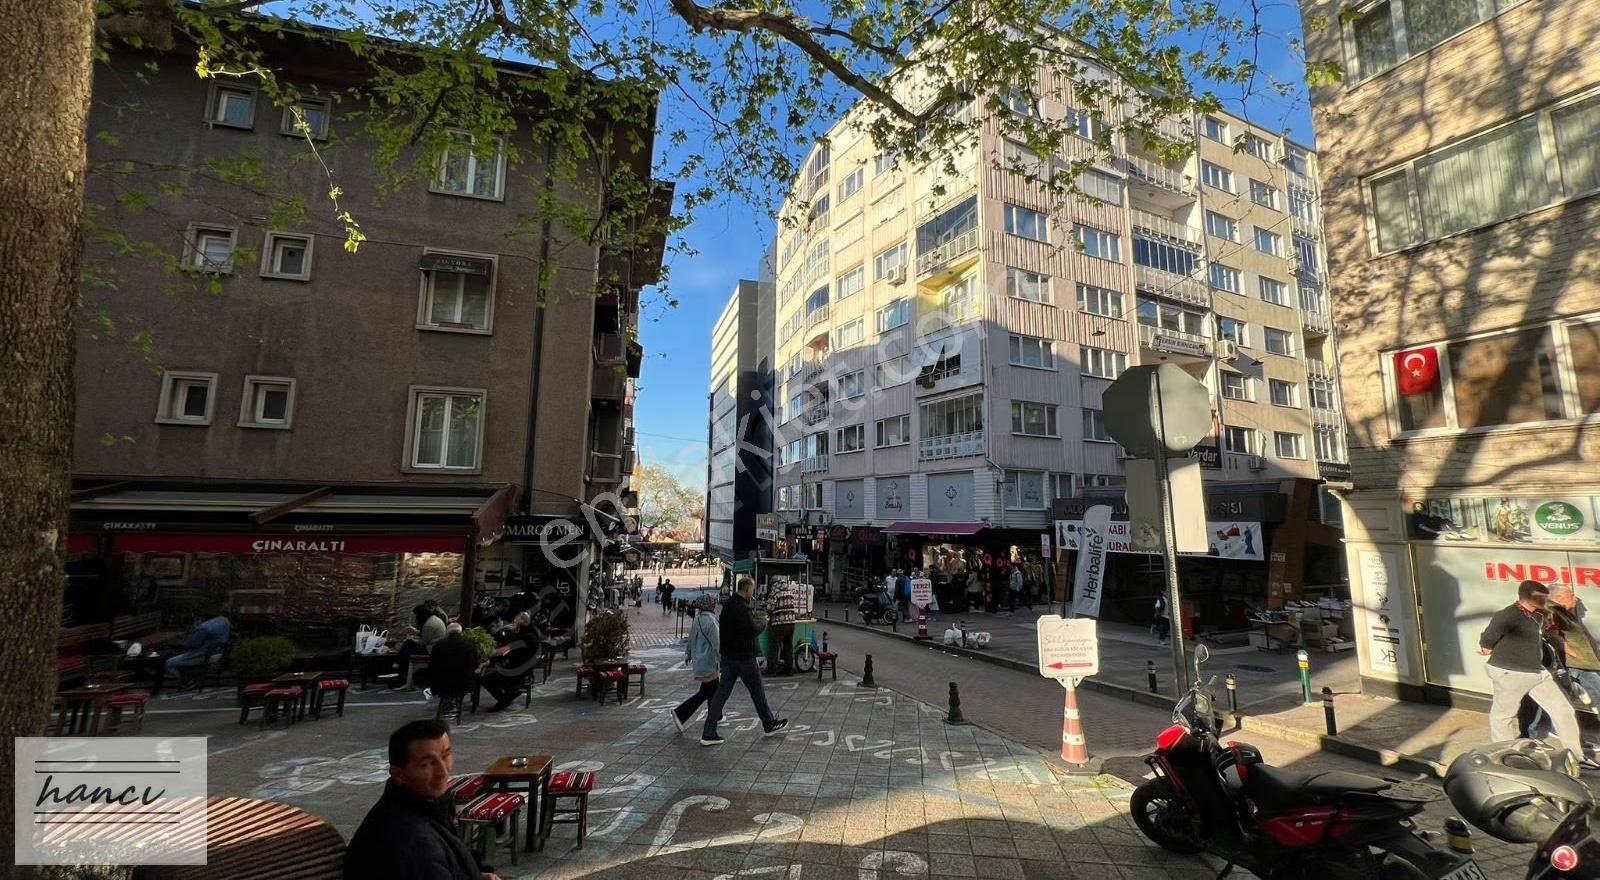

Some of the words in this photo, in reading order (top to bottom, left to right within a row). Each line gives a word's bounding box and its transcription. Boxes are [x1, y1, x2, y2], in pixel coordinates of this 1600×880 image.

[506, 524, 553, 536] MARCO
[556, 524, 584, 536] MEN
[1539, 522, 1581, 530] VENUS
[251, 540, 345, 552] ÇINARALTI
[1083, 534, 1104, 600] Herbalife
